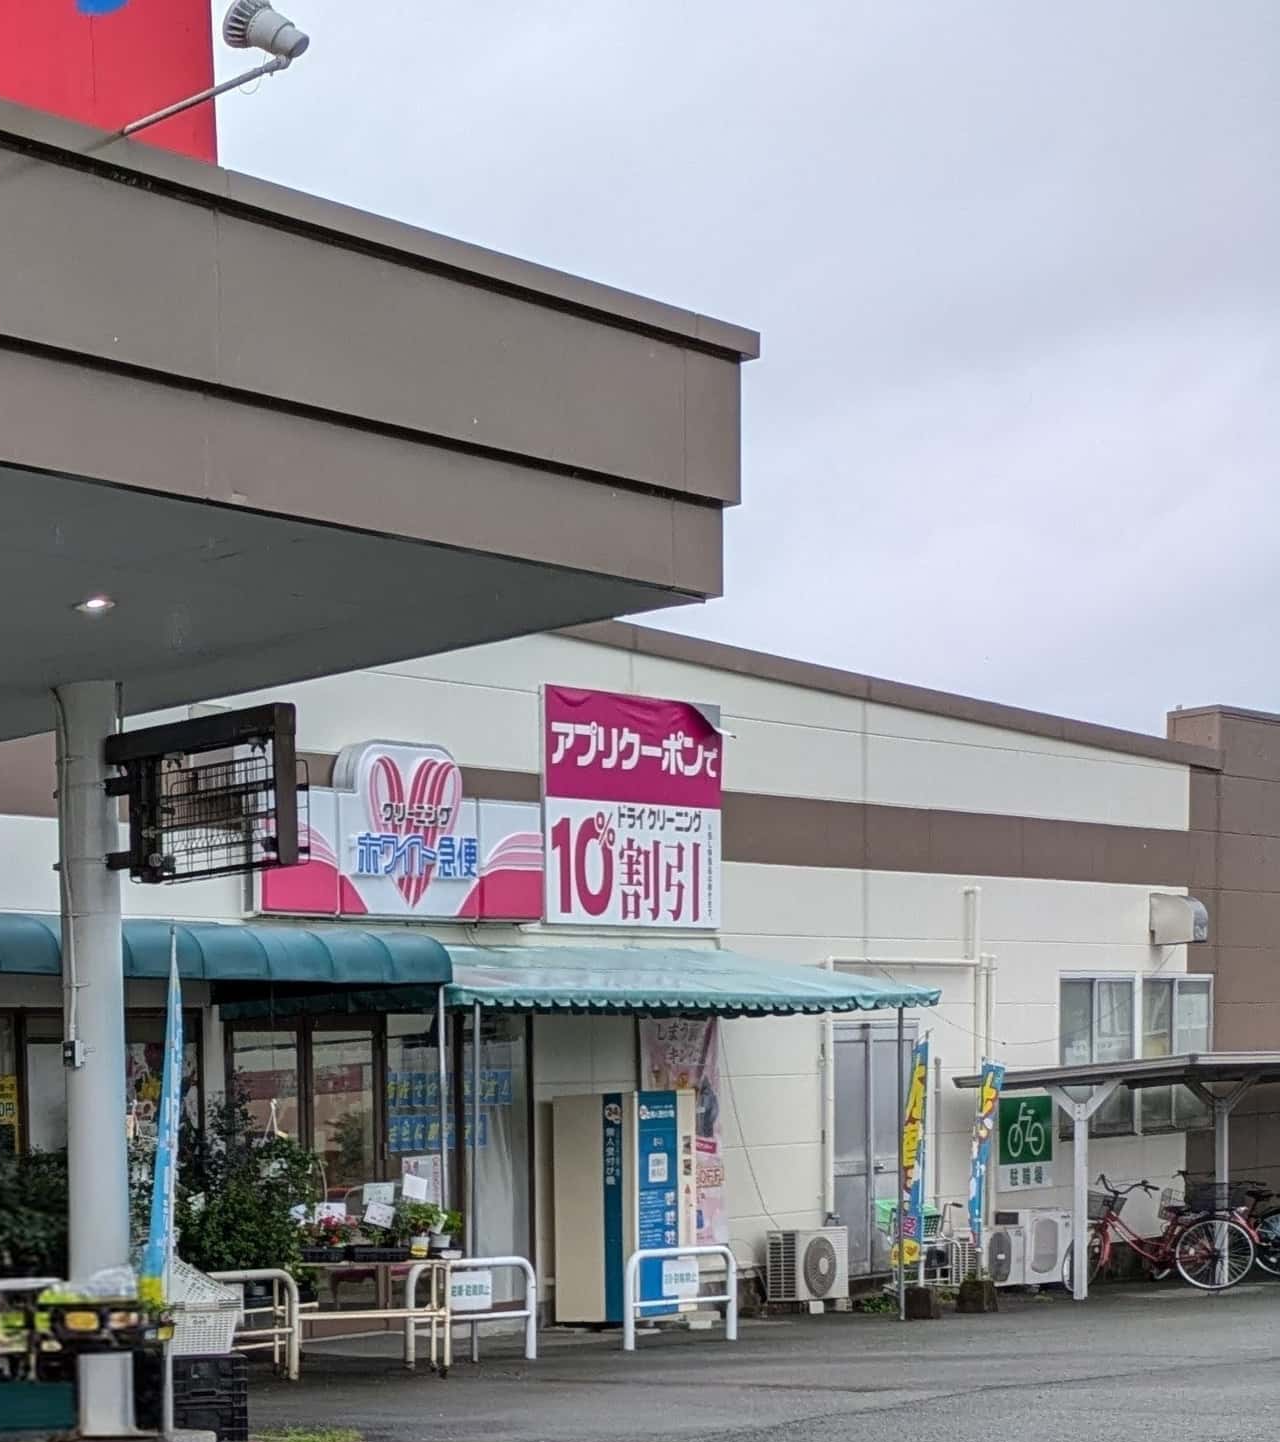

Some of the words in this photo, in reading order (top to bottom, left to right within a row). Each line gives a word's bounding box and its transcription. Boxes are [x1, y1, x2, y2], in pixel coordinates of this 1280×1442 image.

[551, 721, 718, 778] アプリクーポンで
[382, 803, 453, 825] クリーニング
[618, 805, 702, 833] ドライクリーニング
[358, 833, 478, 877] ホワイト急便
